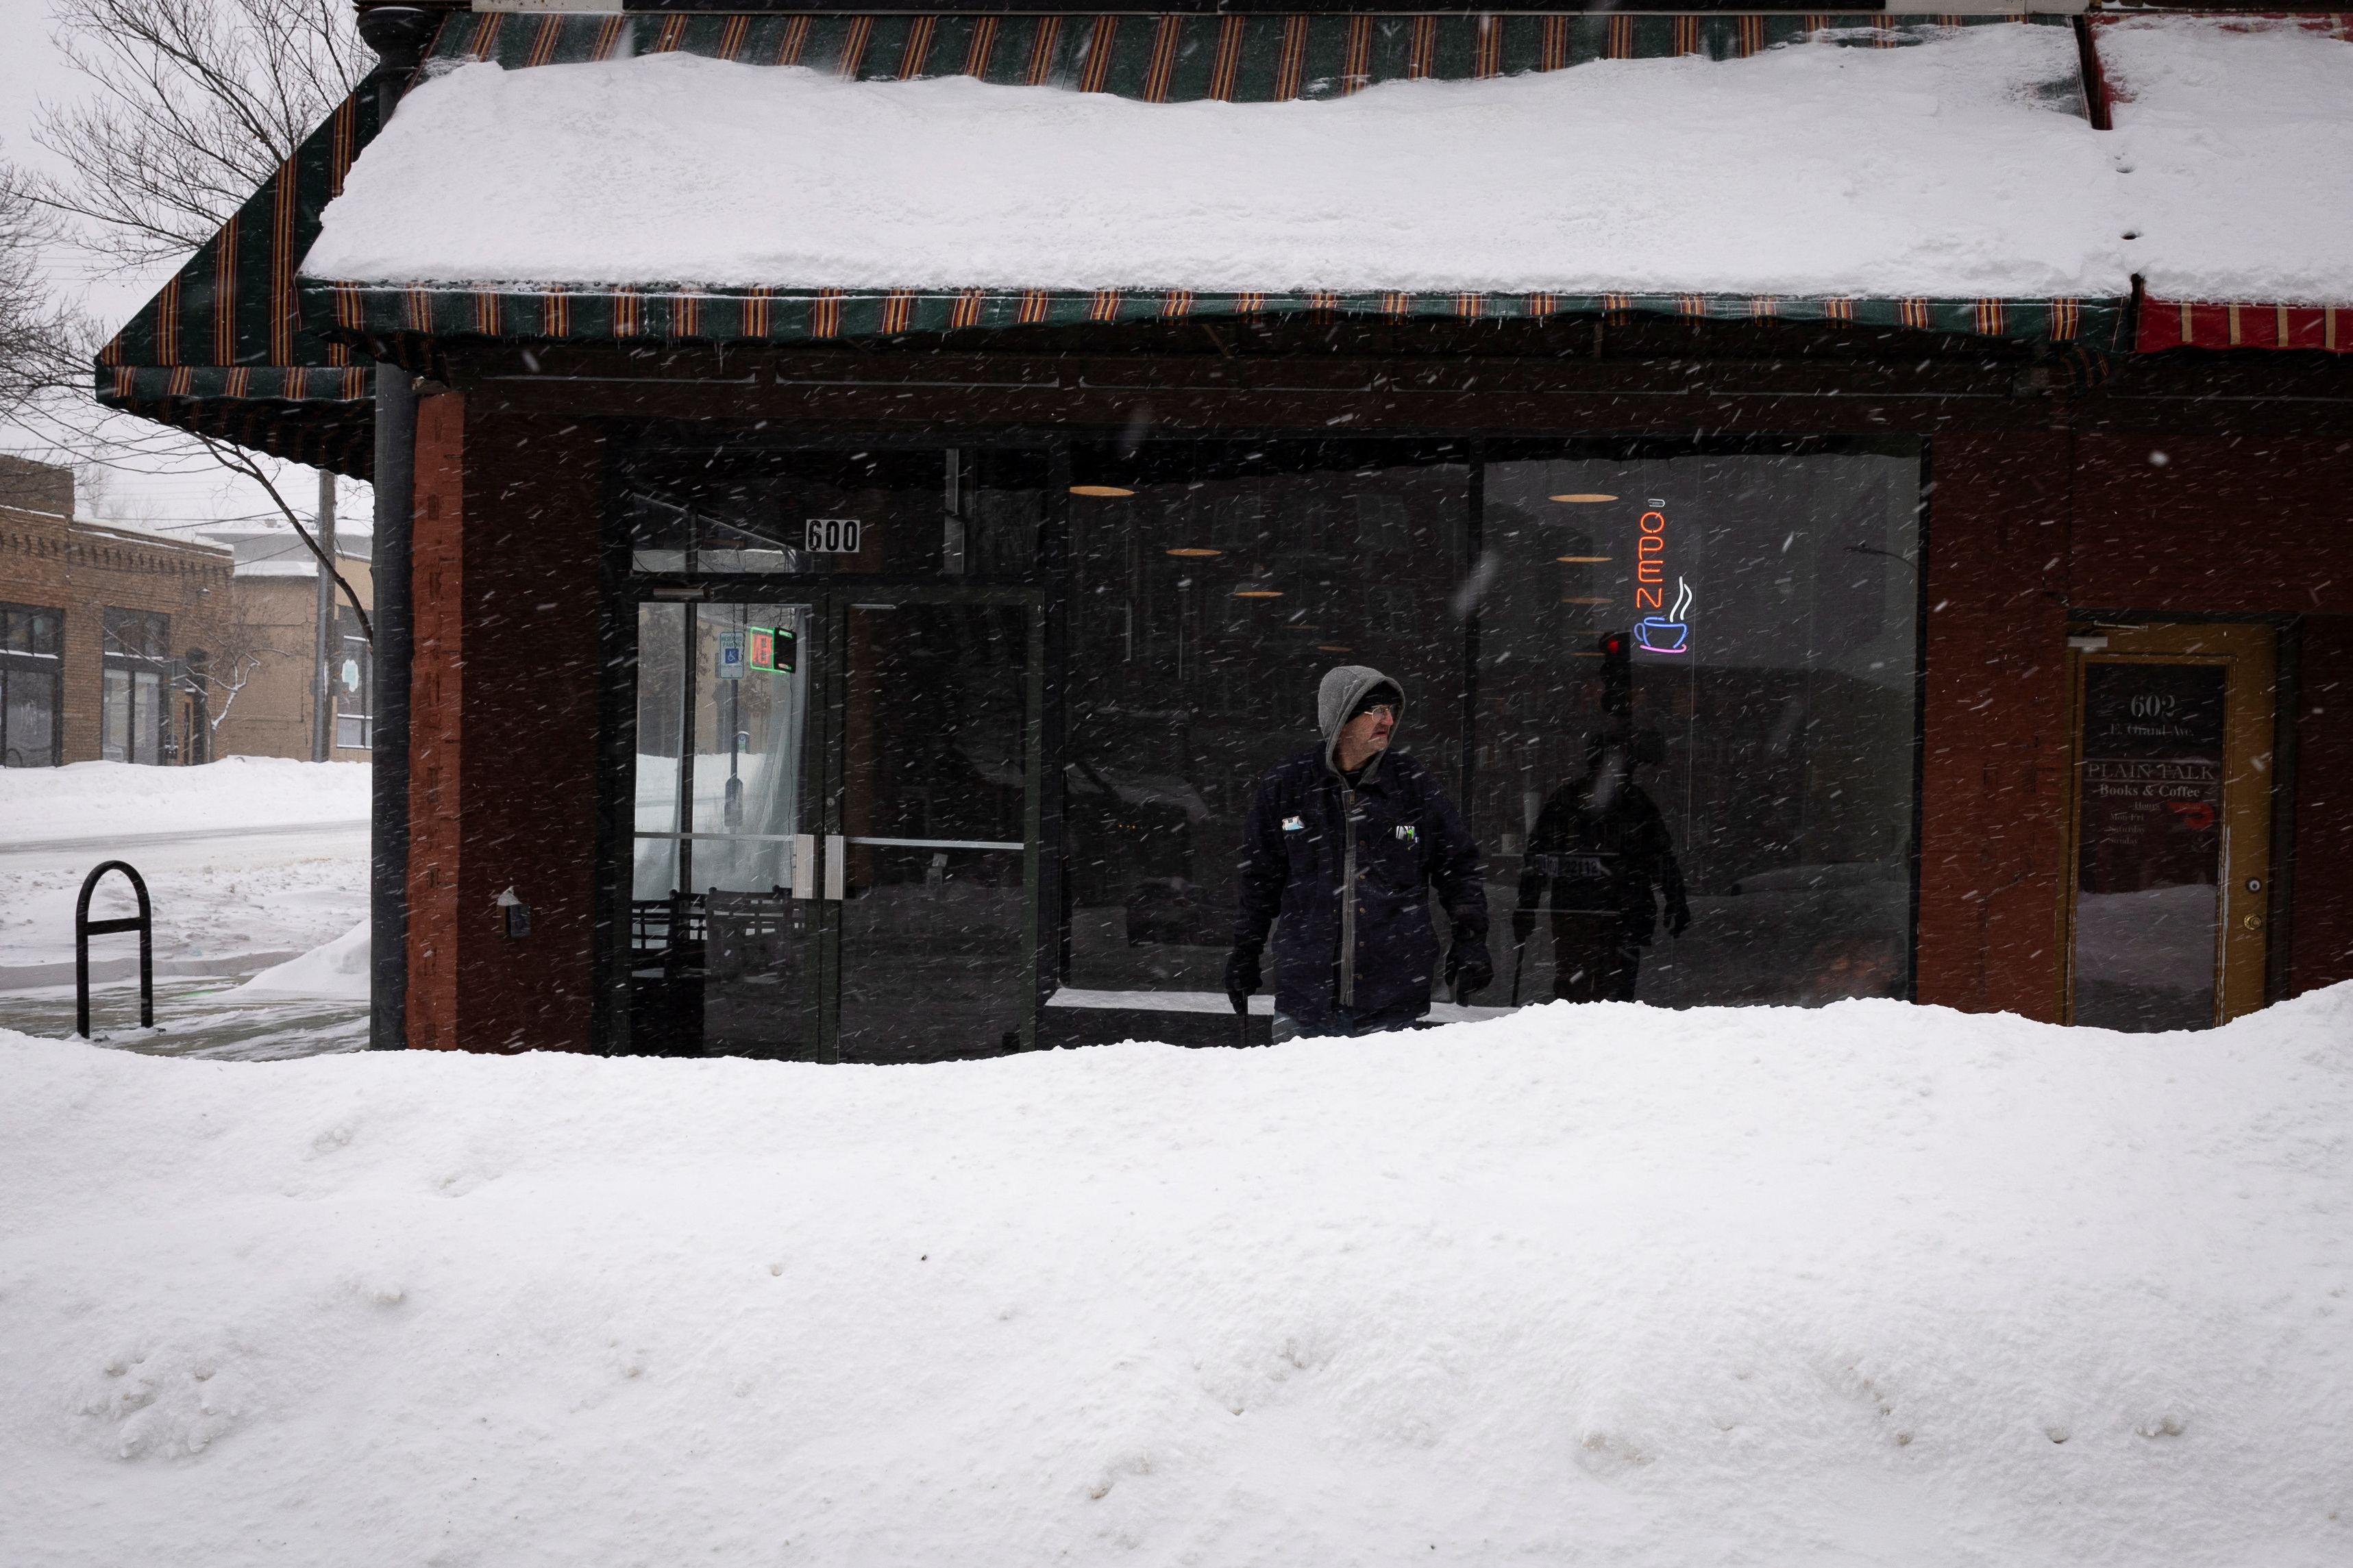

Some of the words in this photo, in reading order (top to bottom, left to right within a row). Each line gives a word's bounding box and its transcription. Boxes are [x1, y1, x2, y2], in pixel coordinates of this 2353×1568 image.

[807, 521, 857, 551] 600
[1636, 512, 1664, 608] OPEN
[2130, 695, 2176, 717] 602
[2110, 723, 2123, 735] E.
[2128, 723, 2165, 736] Grand
[2088, 764, 2151, 779] PLAIN
[2160, 765, 2215, 780] TALK
[2100, 784, 2139, 796] Books
[2143, 785, 2154, 796] &
[2158, 786, 2200, 797] Coffee
[2134, 801, 2160, 810] Hours
[2108, 825, 2145, 834] Saturday
